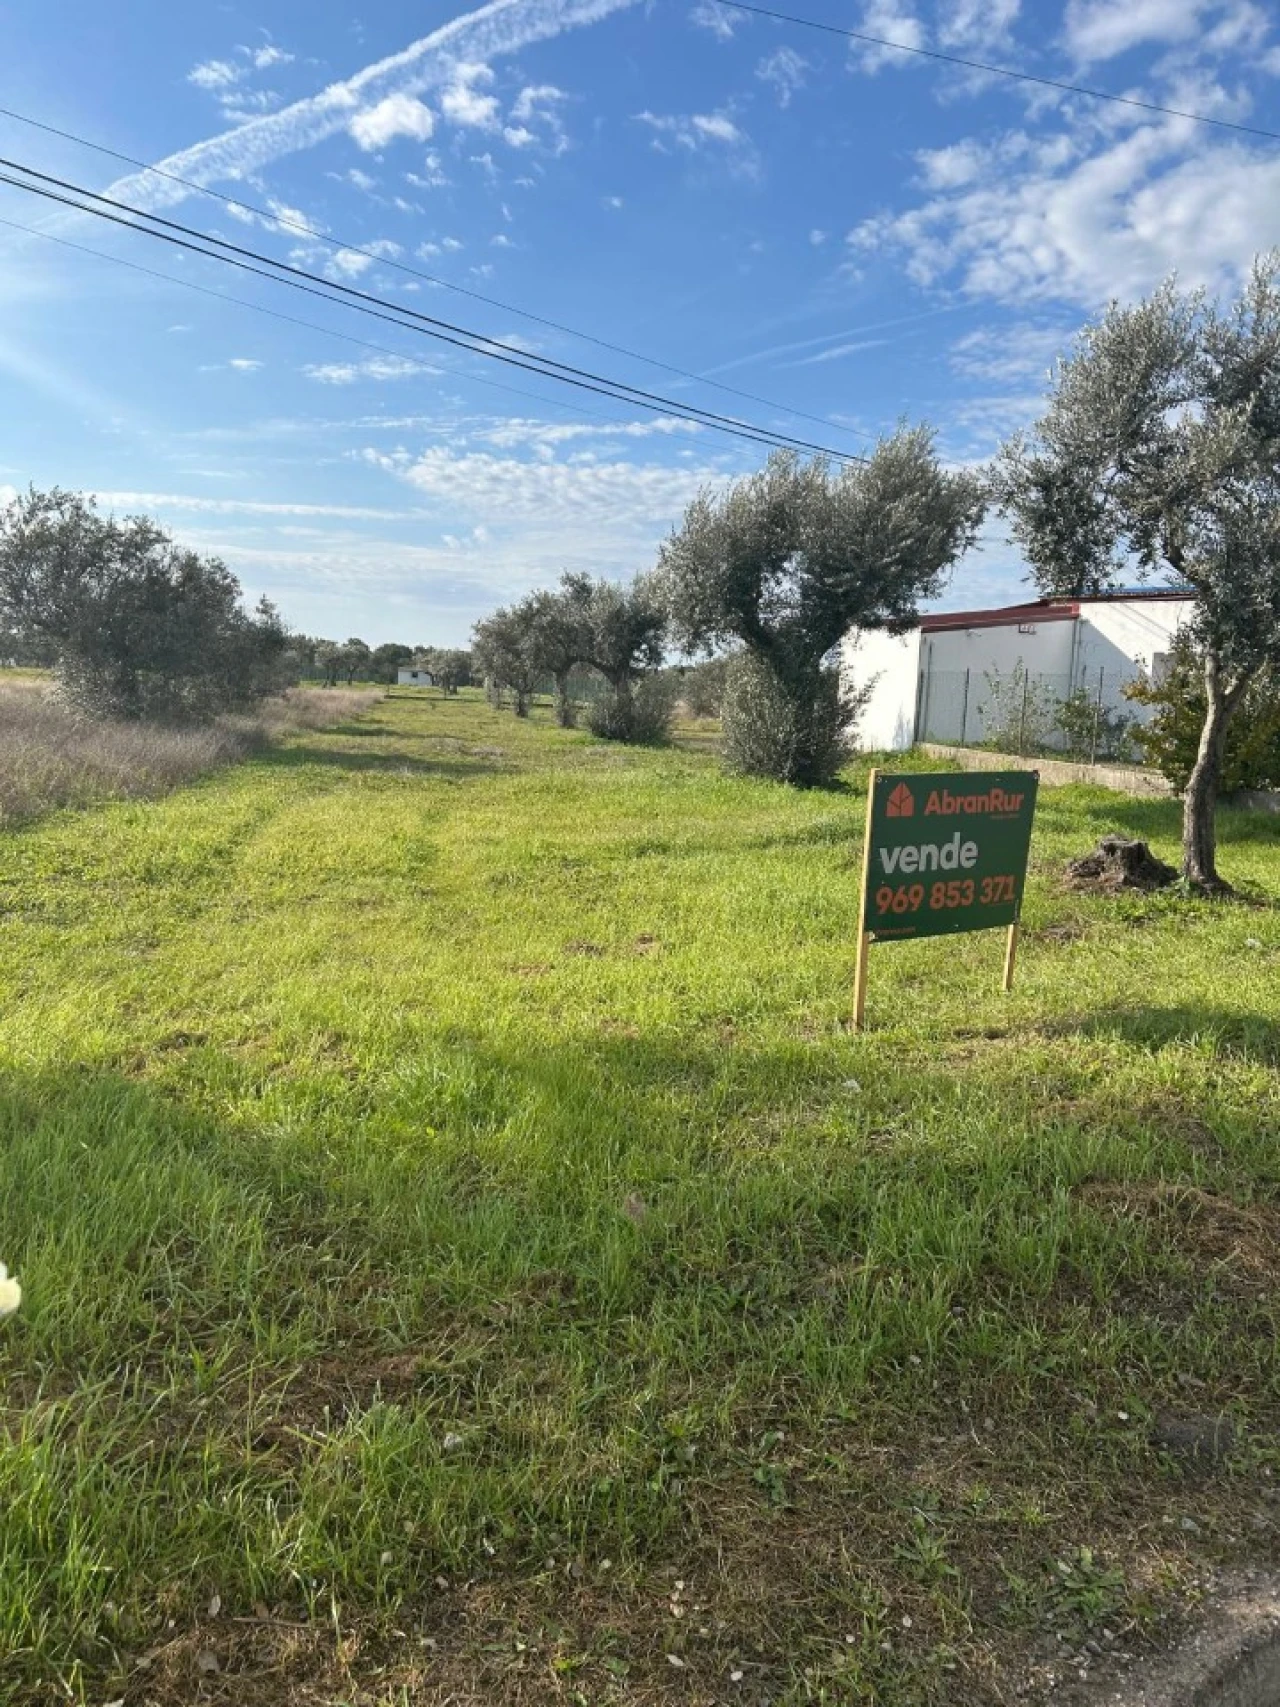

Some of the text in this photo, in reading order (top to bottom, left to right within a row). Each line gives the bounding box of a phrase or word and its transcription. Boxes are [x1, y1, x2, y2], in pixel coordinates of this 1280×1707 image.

[924, 788, 1024, 816] AbranRur
[880, 832, 979, 874] vende
[876, 875, 1016, 914] 969 853 371
